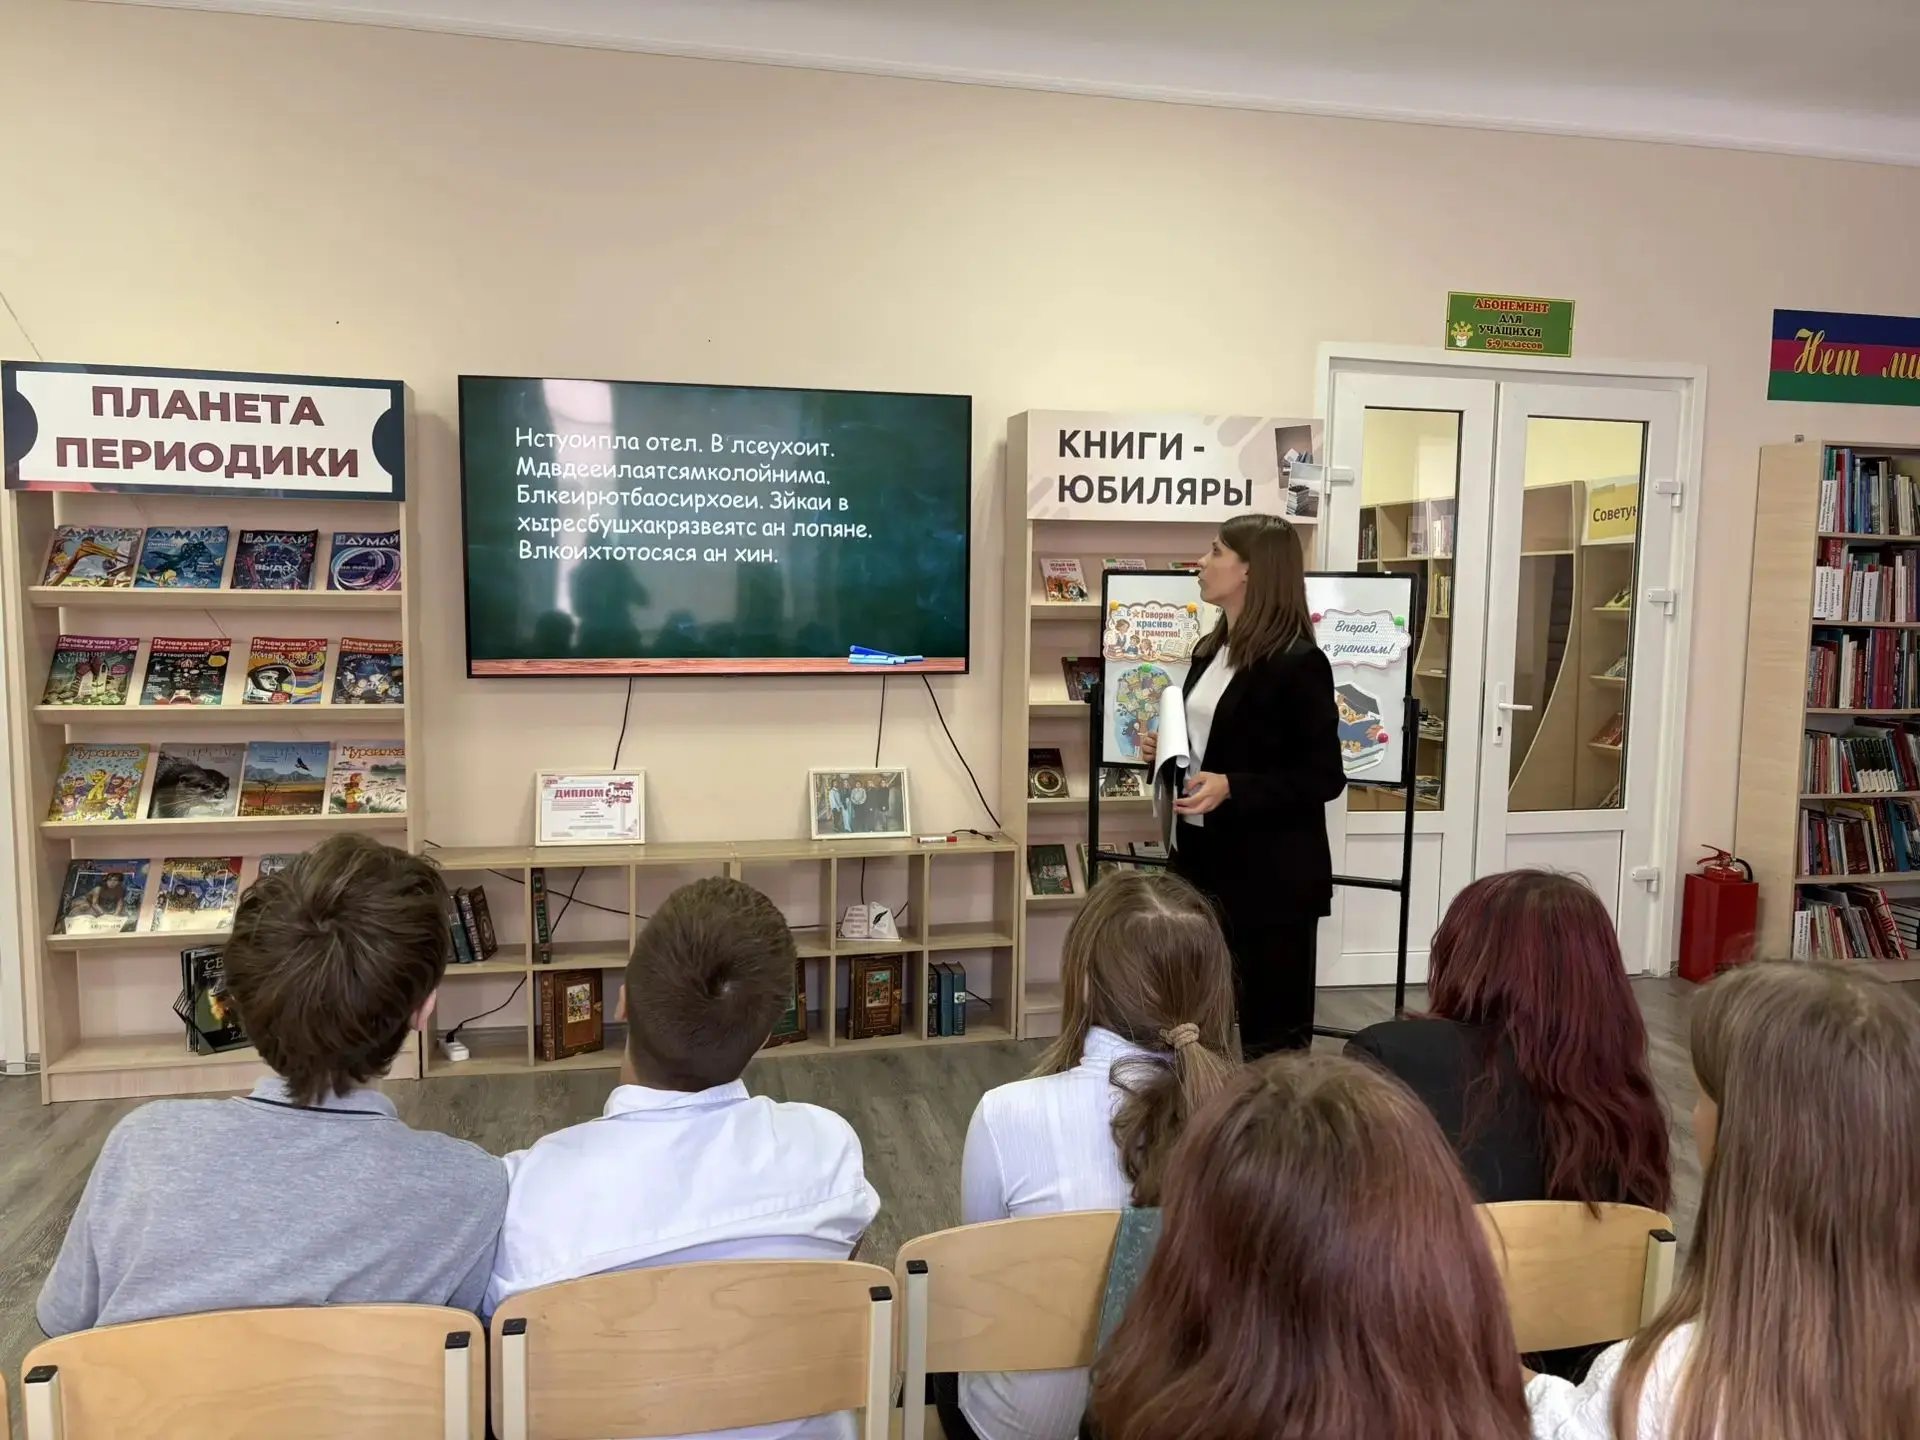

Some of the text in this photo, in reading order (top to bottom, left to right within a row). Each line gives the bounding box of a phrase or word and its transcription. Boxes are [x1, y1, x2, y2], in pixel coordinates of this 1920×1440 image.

[1474, 298, 1550, 313] АБОНЕМЕНТ
[1499, 314, 1523, 324] ДЛЯ
[1479, 325, 1541, 337] УЧАЩИХСЯ
[1486, 339, 1544, 350] 5-9 классов
[1794, 328, 1861, 377] Нет
[92, 386, 325, 426] ПЛАНЕТА
[515, 427, 835, 461] Нстуоипла отел. В лсеухоит.
[1058, 429, 1183, 461] КНИГИ
[56, 437, 359, 480] ПЕРИОДИКИ
[1057, 475, 1254, 506] ЮБИЛЯРЫ
[769, 490, 832, 511] Зйкаи
[838, 497, 849, 511] в
[762, 522, 786, 537] ан
[792, 522, 873, 539] лопяне.
[519, 539, 779, 563] Влкоихтотосяся ан хин.
[1140, 610, 1175, 620] Говорим
[1136, 619, 1173, 629] красиво
[1141, 629, 1181, 638] грамотно!
[1333, 643, 1396, 657] знаниям!
[554, 788, 604, 799] ДИПЛОМ
